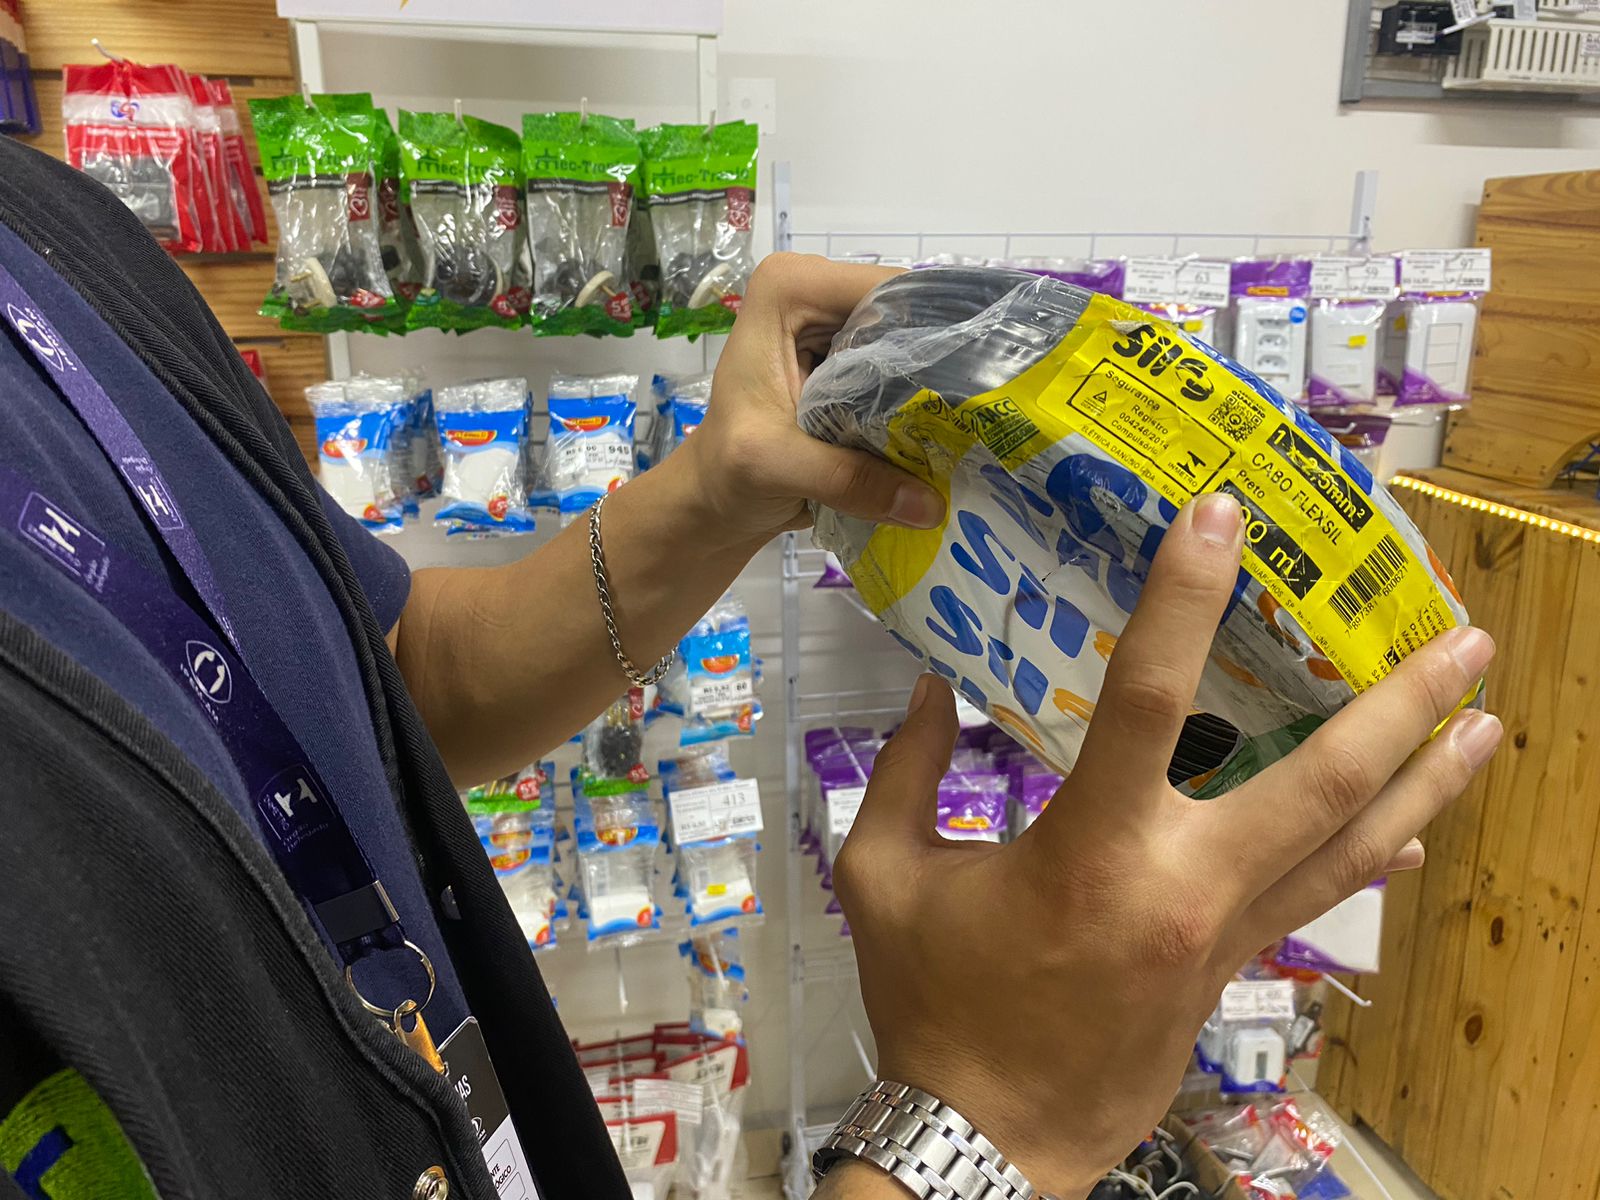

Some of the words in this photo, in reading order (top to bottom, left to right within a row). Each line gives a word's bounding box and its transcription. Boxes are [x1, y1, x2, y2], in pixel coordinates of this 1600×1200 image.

[1130, 404, 1169, 436] Registro
[1235, 469, 1265, 500] Preto
[1251, 452, 1293, 493] CABO
[1291, 489, 1343, 546] FLEXSIL
[1351, 600, 1379, 631] 897381
[1382, 565, 1408, 597] 600621
